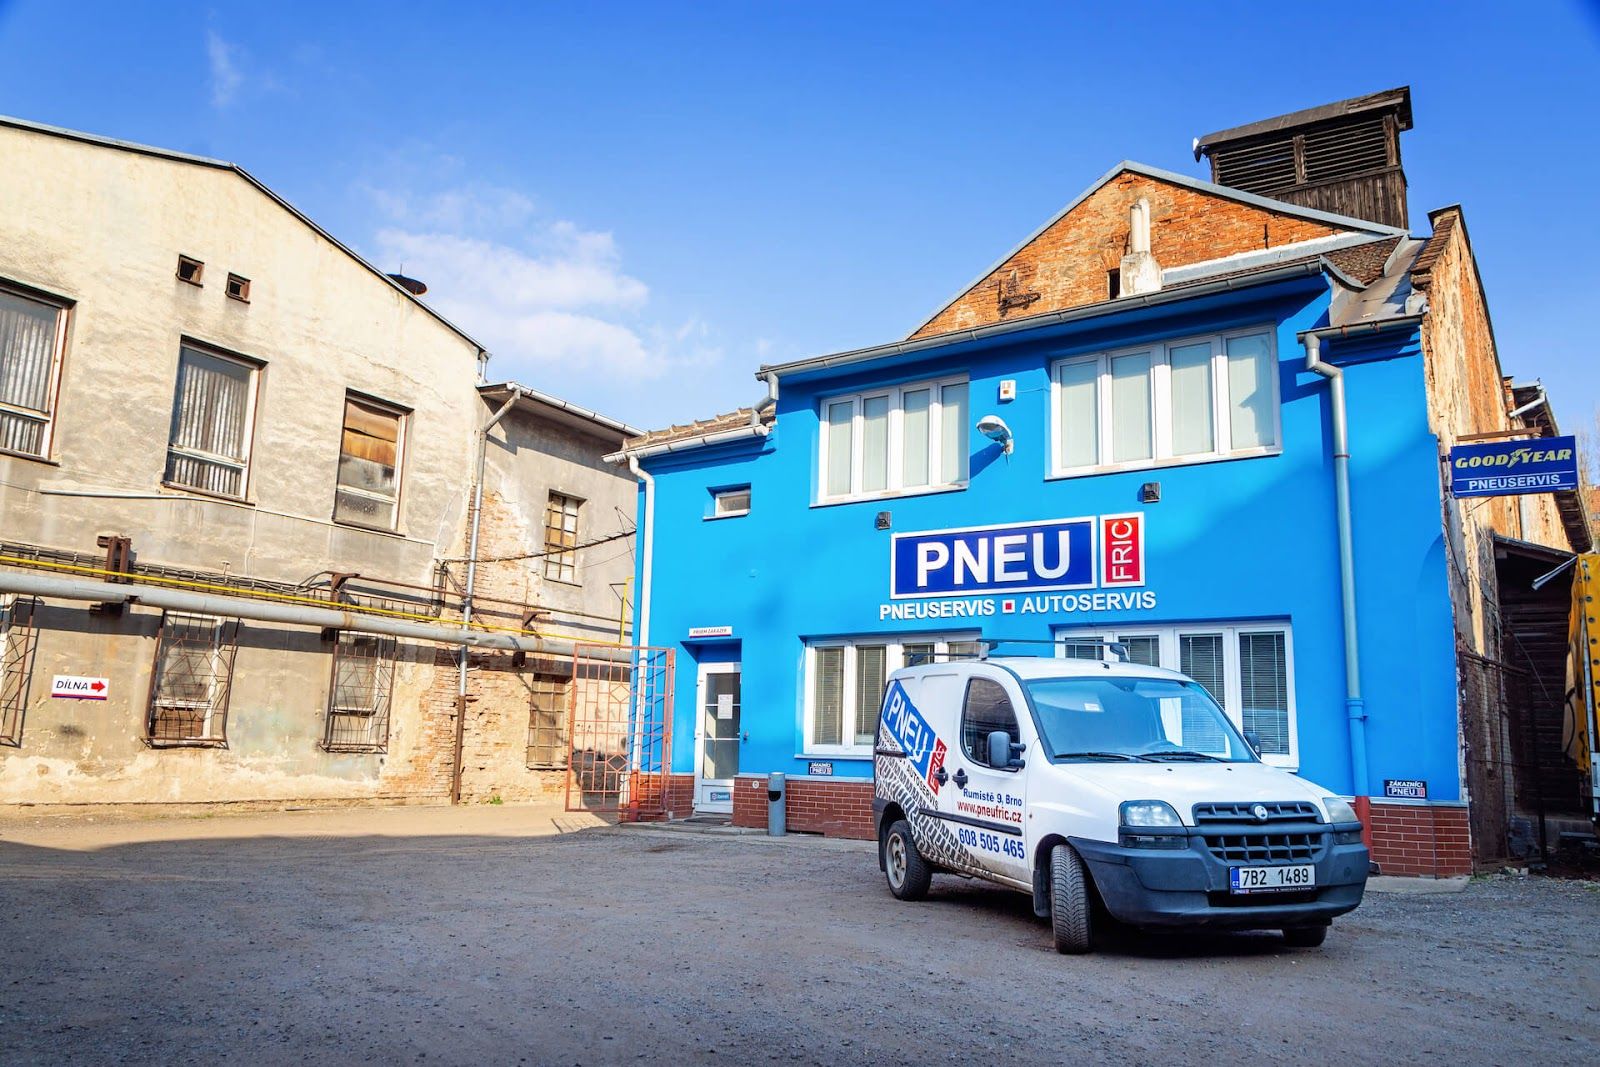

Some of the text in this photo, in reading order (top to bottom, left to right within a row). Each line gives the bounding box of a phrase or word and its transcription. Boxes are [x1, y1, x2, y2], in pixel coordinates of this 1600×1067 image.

[1468, 474, 1560, 490] PNEUSERVIS
[917, 530, 1070, 587] PNEU
[1111, 520, 1133, 580] FRIC
[879, 591, 1156, 620] PNEUSERVIS AUTOSERVIS
[56, 679, 88, 690] DÍLNA
[887, 691, 928, 763] PNEU
[906, 764, 939, 811] AUTOSERVIS
[1005, 794, 1022, 807] Brno
[957, 801, 1022, 823] www.pneufric.cz
[959, 828, 1025, 859] 608 505 465
[1242, 868, 1309, 886] 7B2 1489
